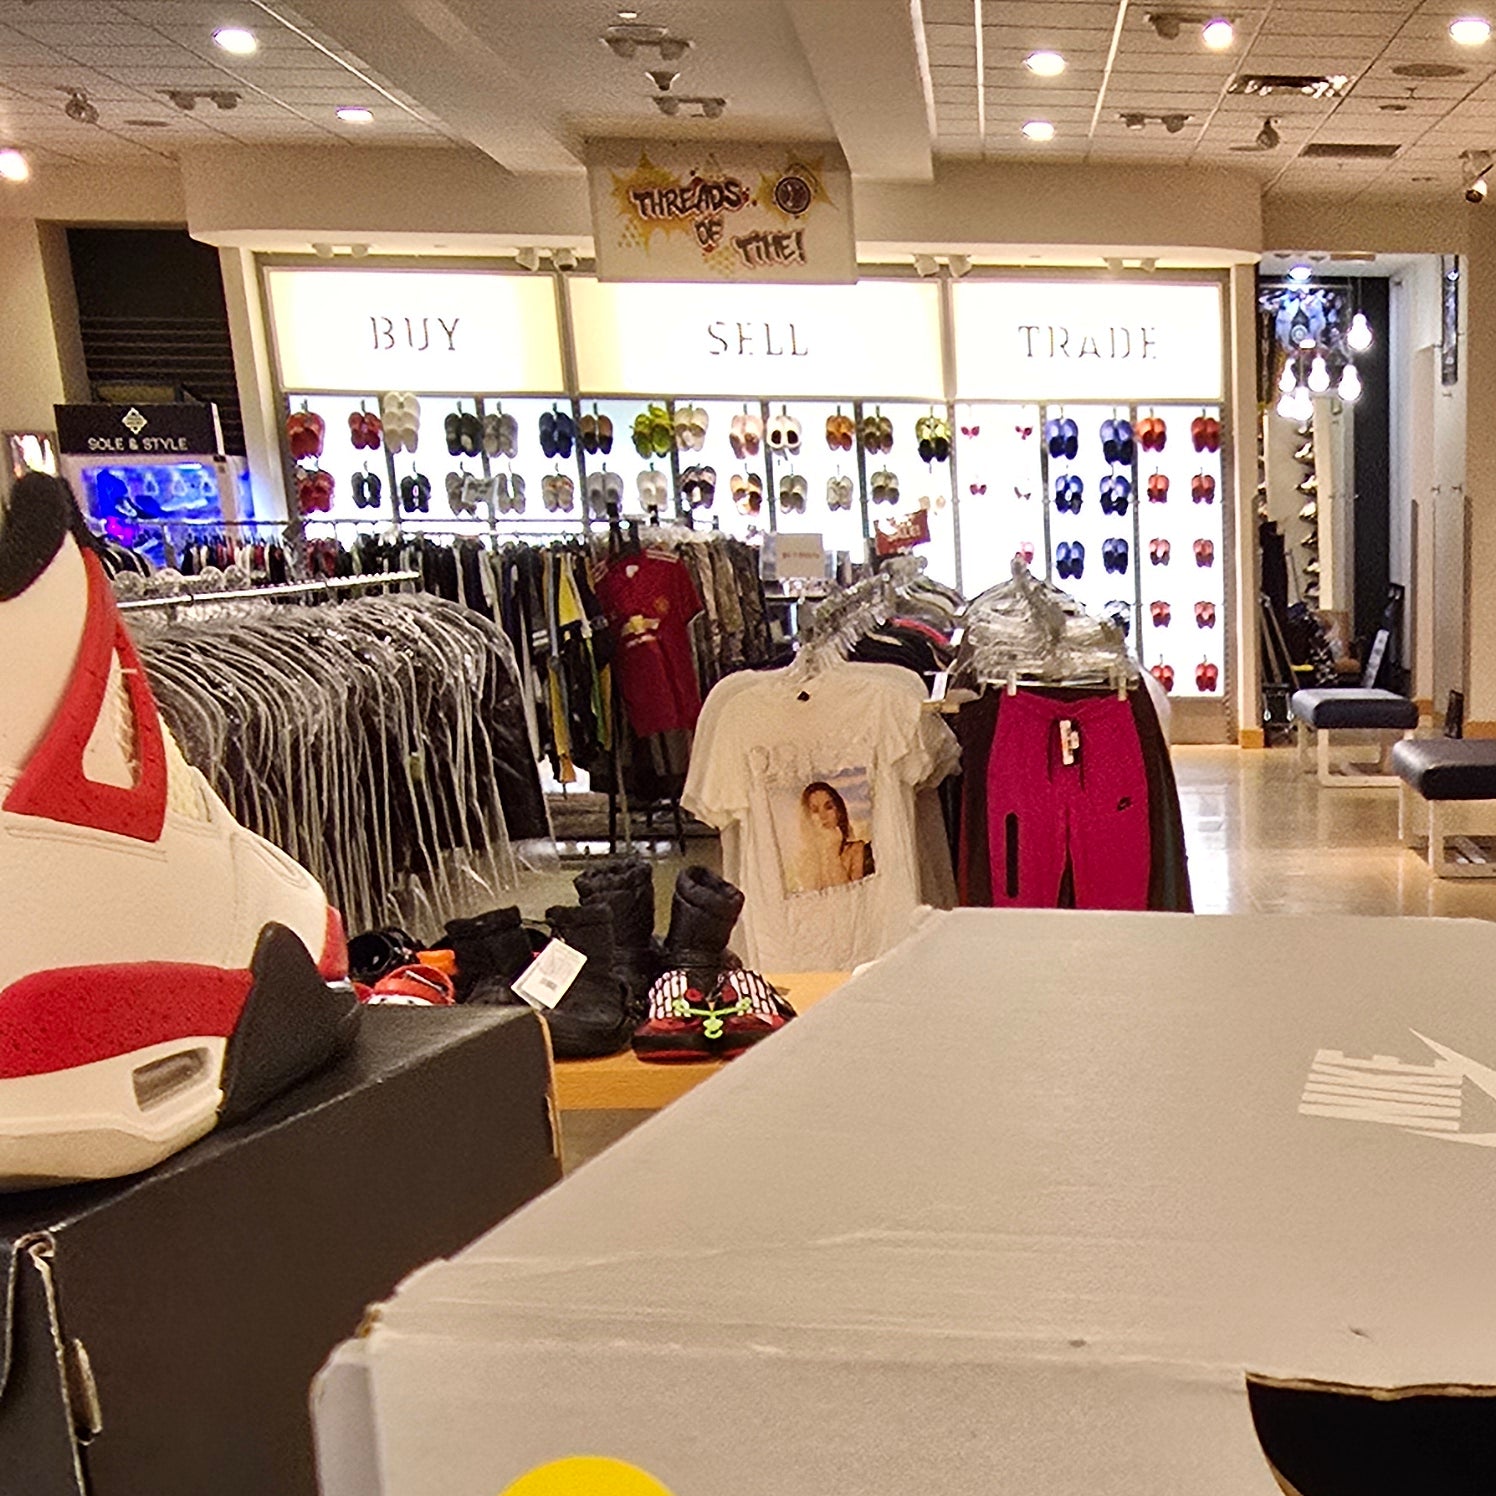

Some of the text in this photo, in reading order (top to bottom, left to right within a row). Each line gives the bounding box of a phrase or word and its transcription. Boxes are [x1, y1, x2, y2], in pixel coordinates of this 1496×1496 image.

[630, 178, 743, 219] THREADS
[694, 216, 723, 247] OF
[370, 316, 460, 351] BUY
[708, 321, 809, 356] SELL
[1018, 325, 1157, 359] TRADE
[88, 437, 124, 451] SOLE
[143, 437, 189, 451] STYLE
[1298, 1048, 1463, 1131] NIKE
